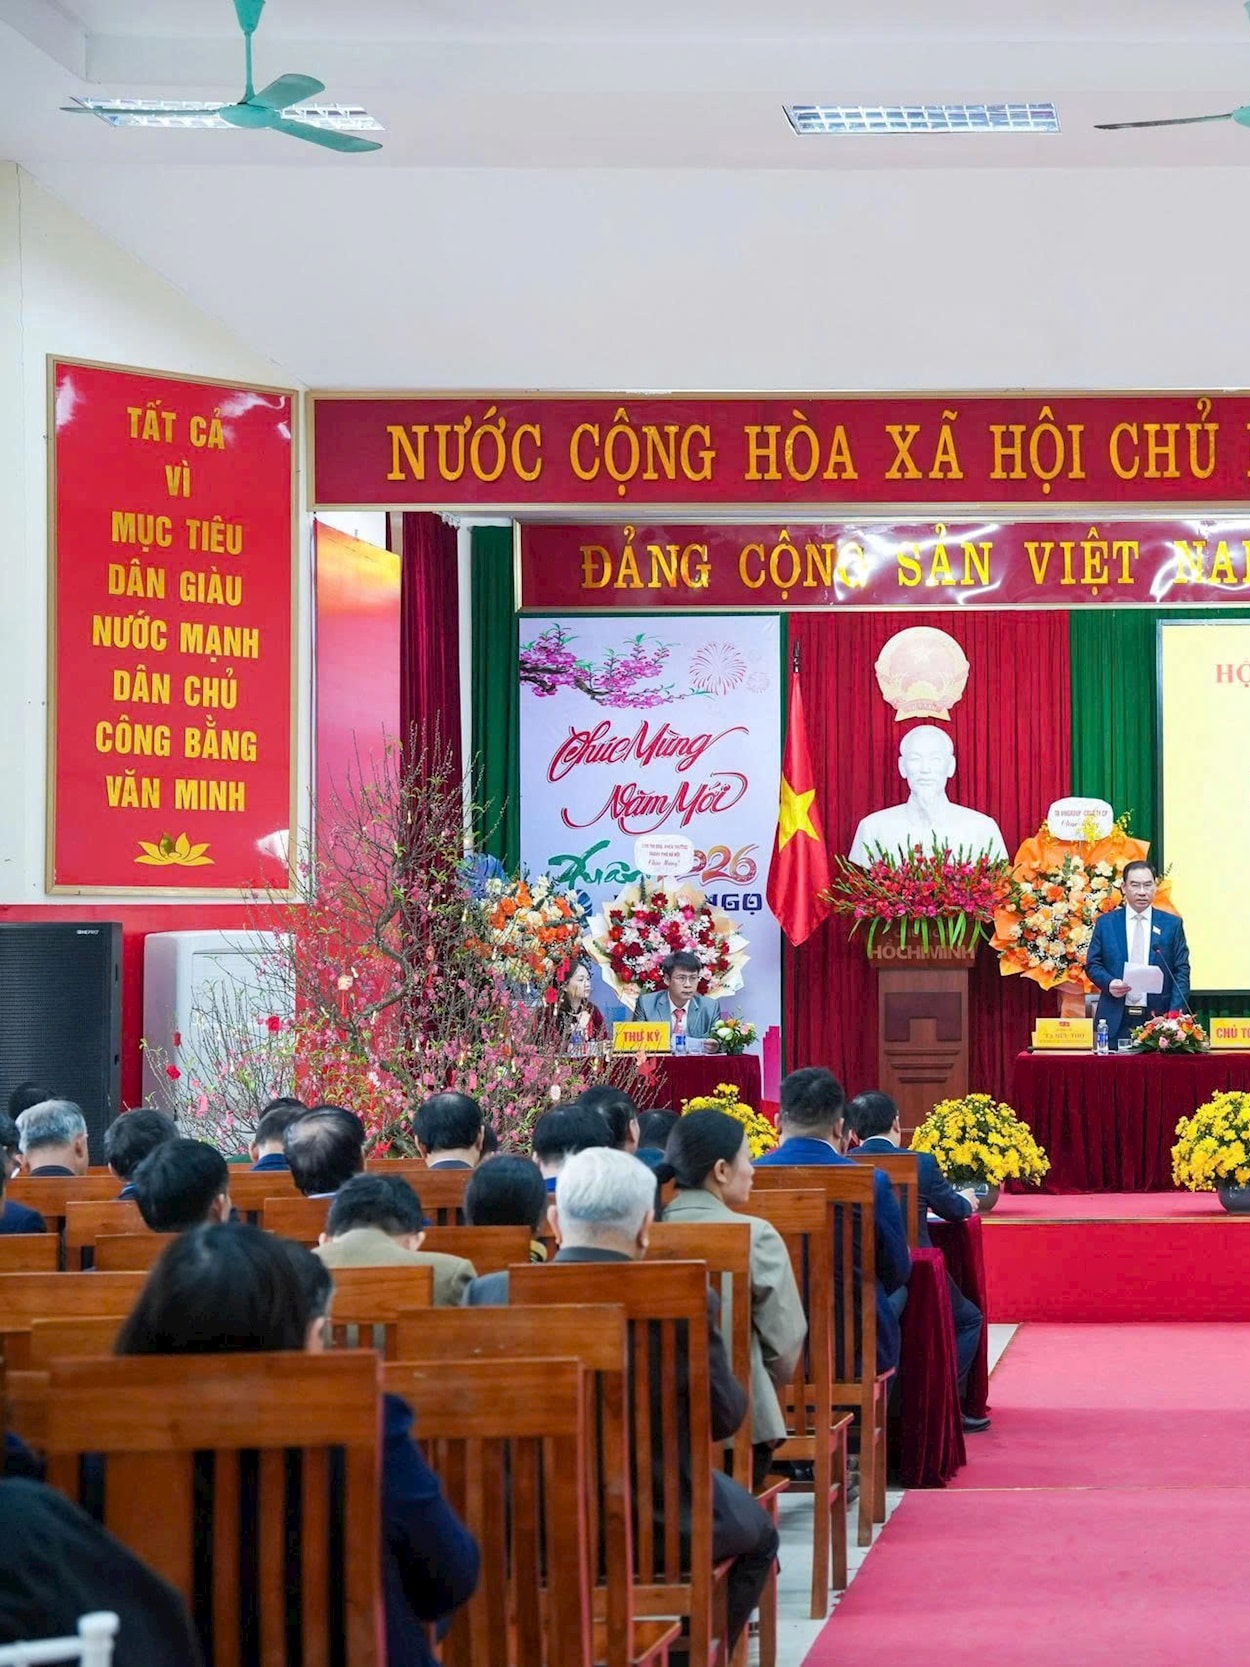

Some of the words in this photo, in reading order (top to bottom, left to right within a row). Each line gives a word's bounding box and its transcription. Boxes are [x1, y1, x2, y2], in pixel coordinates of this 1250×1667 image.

[128, 398, 176, 442] TẤT
[190, 409, 225, 450] CẢ
[386, 407, 542, 482] NƯỚC
[570, 408, 716, 495] CỘNG
[744, 409, 858, 481] HÒA
[885, 410, 964, 479] XÃ
[989, 405, 1085, 494] HỘI
[1109, 397, 1219, 479] CHỦ
[166, 461, 190, 498] VÌ
[111, 511, 172, 553] MỤC
[186, 515, 242, 555] TIÊU
[108, 558, 165, 599] DÂN
[180, 566, 242, 607] GIÀU
[580, 525, 712, 589] ĐẢNG
[739, 529, 867, 599] CỘNG
[897, 523, 994, 588] SẢN
[1023, 526, 1140, 596] VIỆT
[92, 609, 167, 652] NƯỚC
[179, 622, 259, 663] MẠNH
[113, 664, 170, 705] DÂN
[184, 667, 238, 710] CHỦ
[95, 714, 171, 757] CÔNG
[184, 715, 257, 762] BẰNG
[106, 769, 160, 809] VĂN
[175, 778, 245, 812] MINH
[656, 843, 760, 886] 26
[1216, 1024, 1238, 1039] CHỦ
